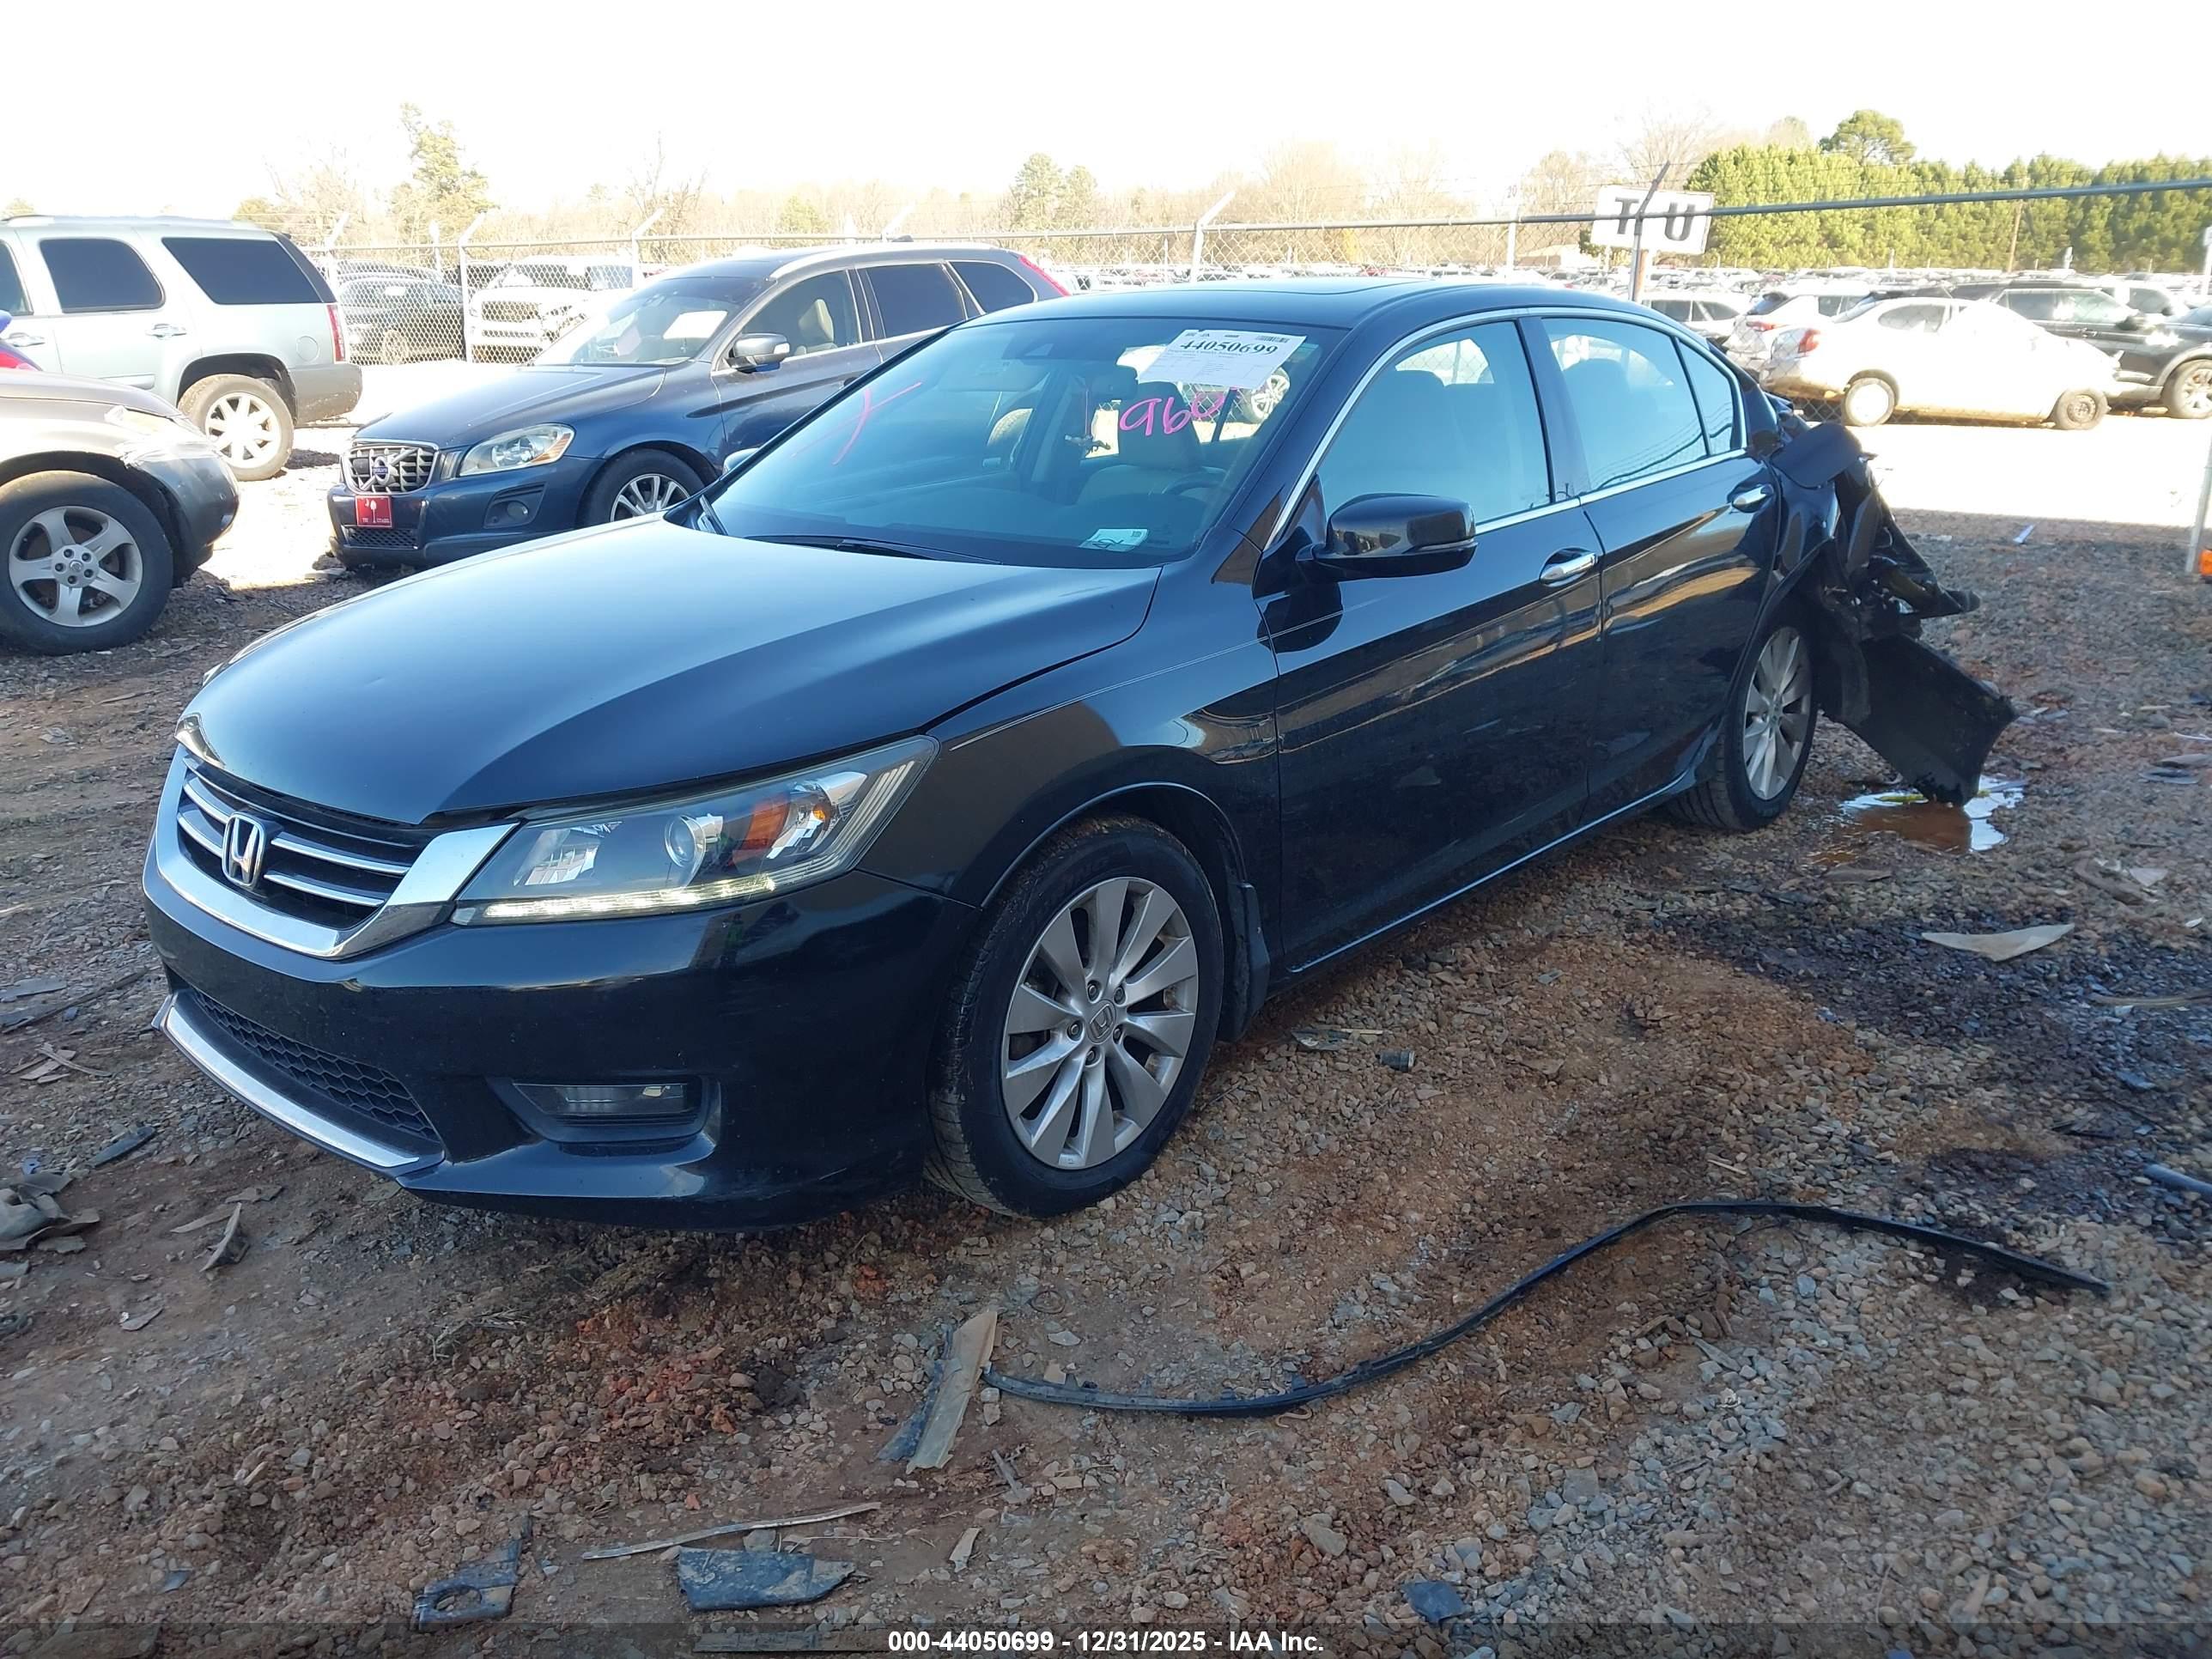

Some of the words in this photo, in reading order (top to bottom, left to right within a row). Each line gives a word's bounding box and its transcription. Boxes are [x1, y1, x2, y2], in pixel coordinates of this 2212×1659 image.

[1614, 197, 1639, 235] T
[1664, 202, 1696, 241] U
[1179, 340, 1279, 356] 44050699
